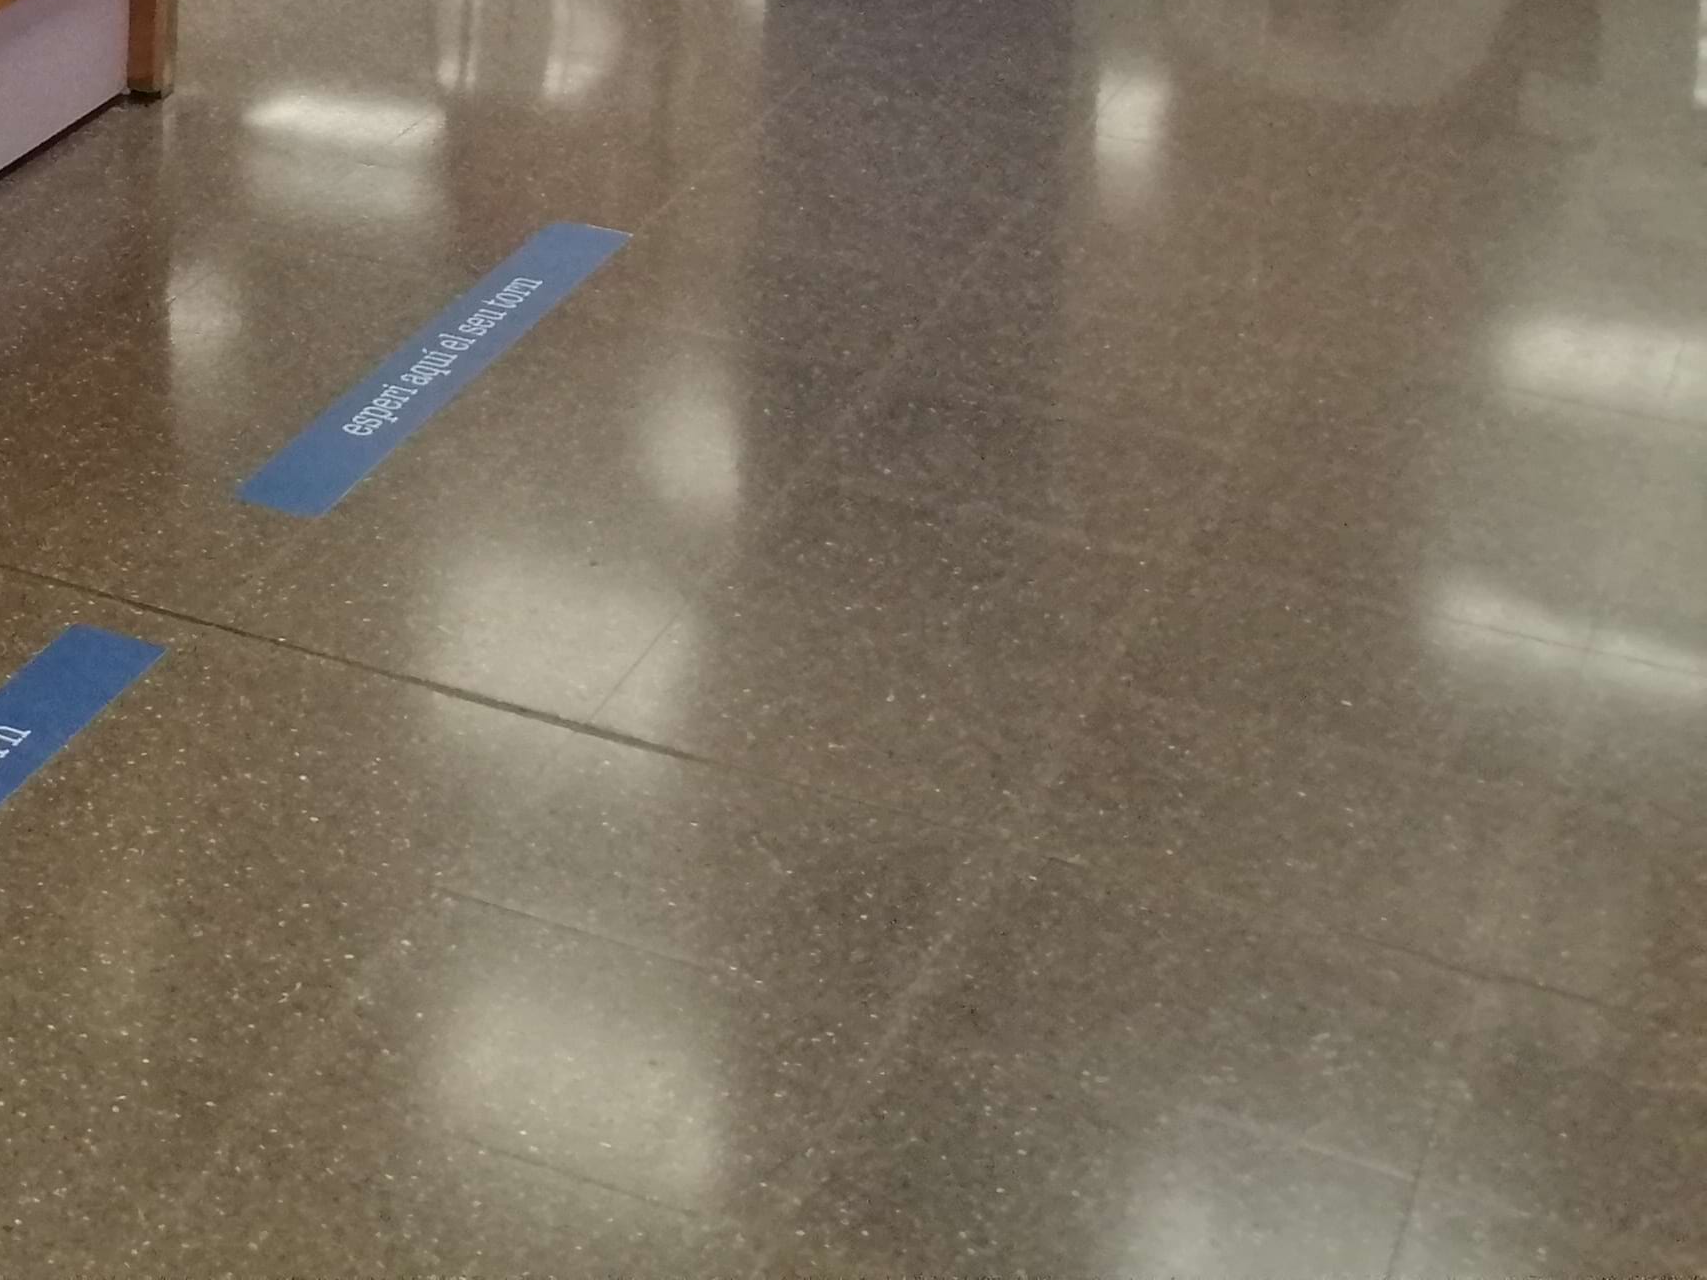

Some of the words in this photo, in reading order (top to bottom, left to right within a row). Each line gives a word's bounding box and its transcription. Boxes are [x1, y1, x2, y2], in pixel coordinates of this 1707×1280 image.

[482, 276, 543, 309] torn
[459, 308, 507, 336] seu
[437, 333, 477, 352] el
[400, 347, 458, 386] aquí
[342, 383, 418, 436] esperi
